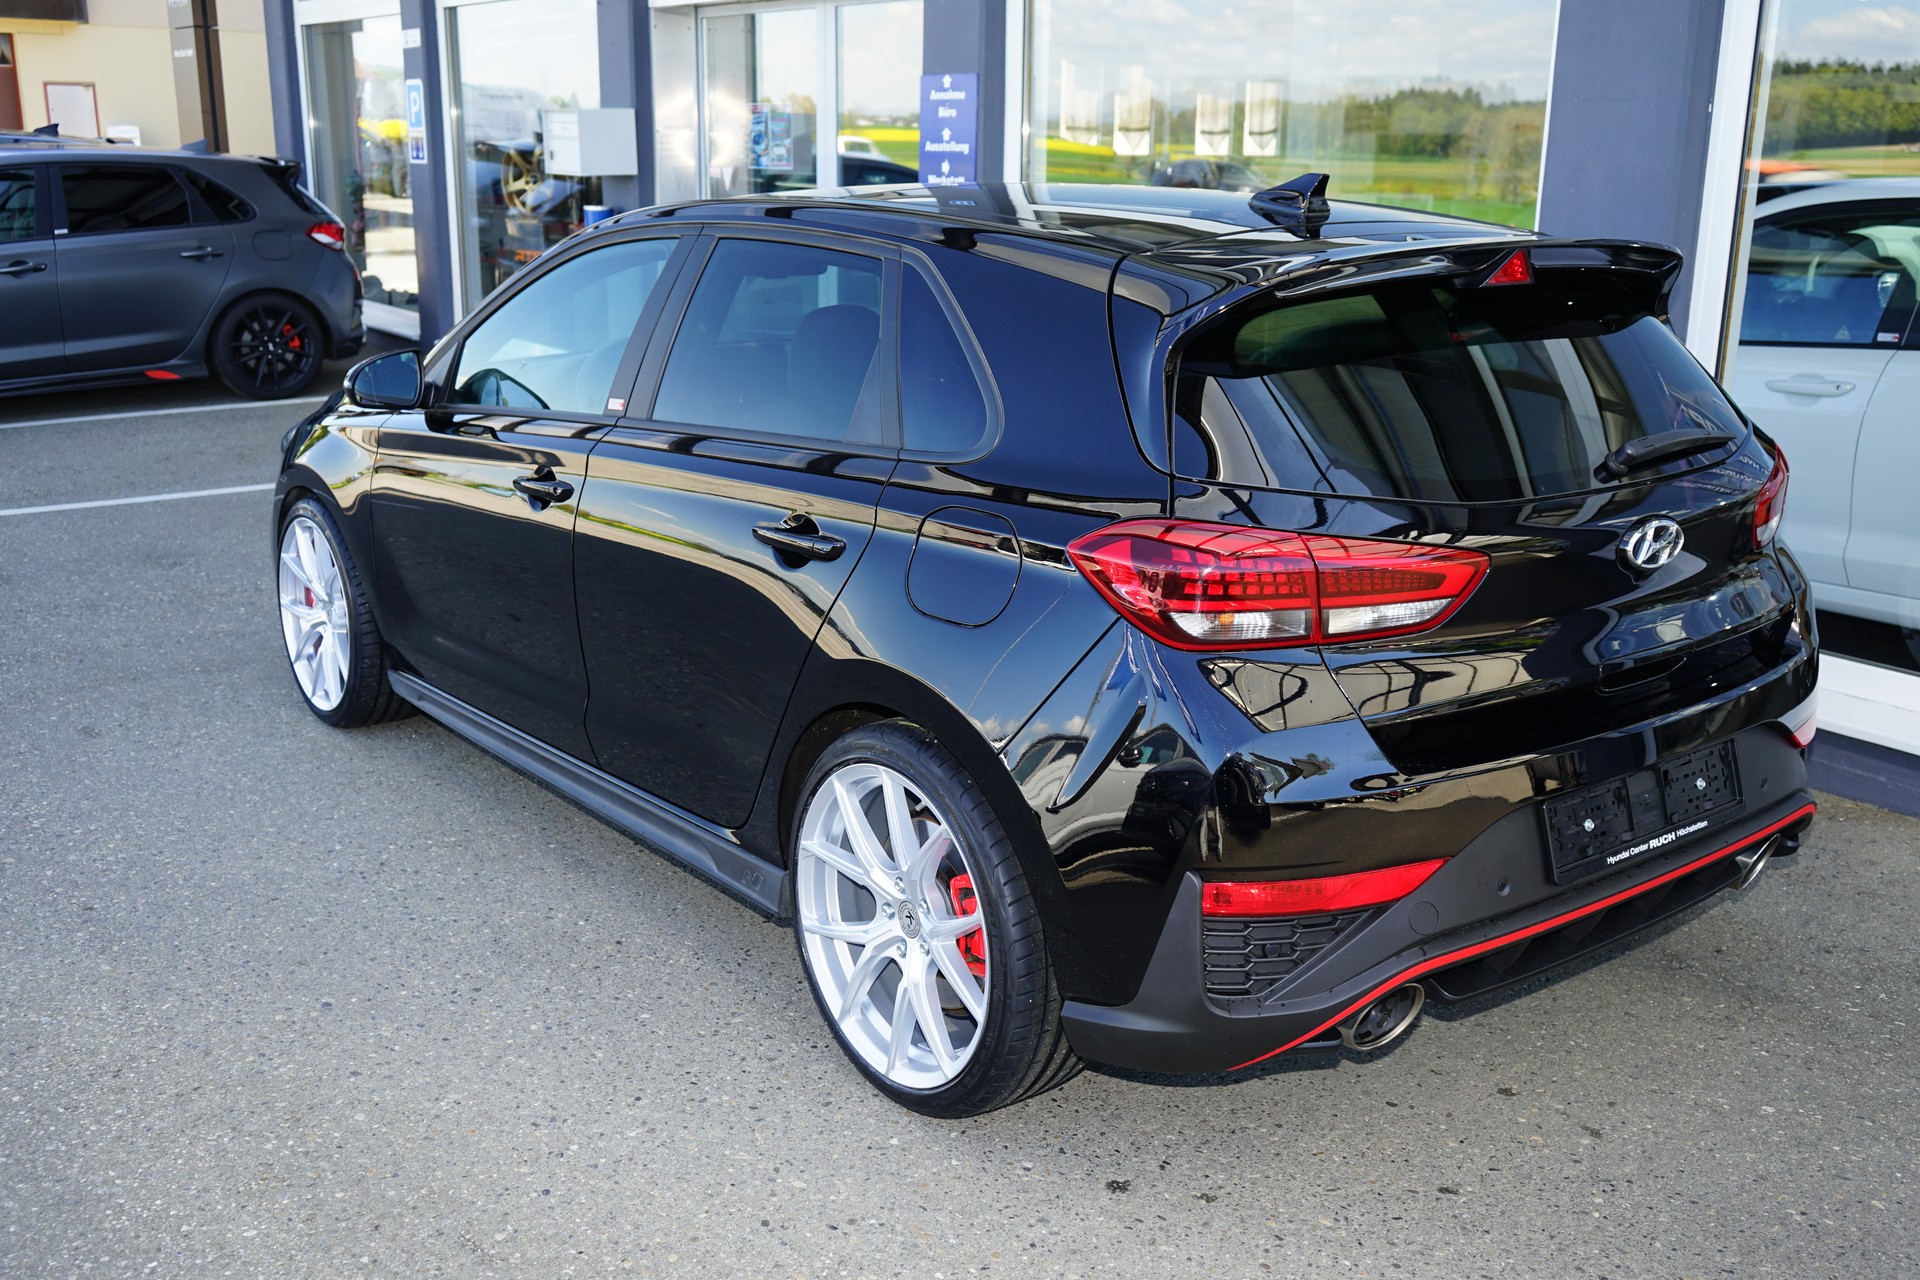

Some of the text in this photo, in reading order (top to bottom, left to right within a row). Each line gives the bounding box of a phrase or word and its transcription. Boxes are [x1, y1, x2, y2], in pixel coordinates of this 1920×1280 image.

[929, 89, 966, 100] Annahme
[409, 90, 420, 123] P
[937, 106, 957, 118] Büro
[925, 140, 970, 155] Ausstellung
[1606, 820, 1709, 865] Hyundai Center RUCH Höchstetten
